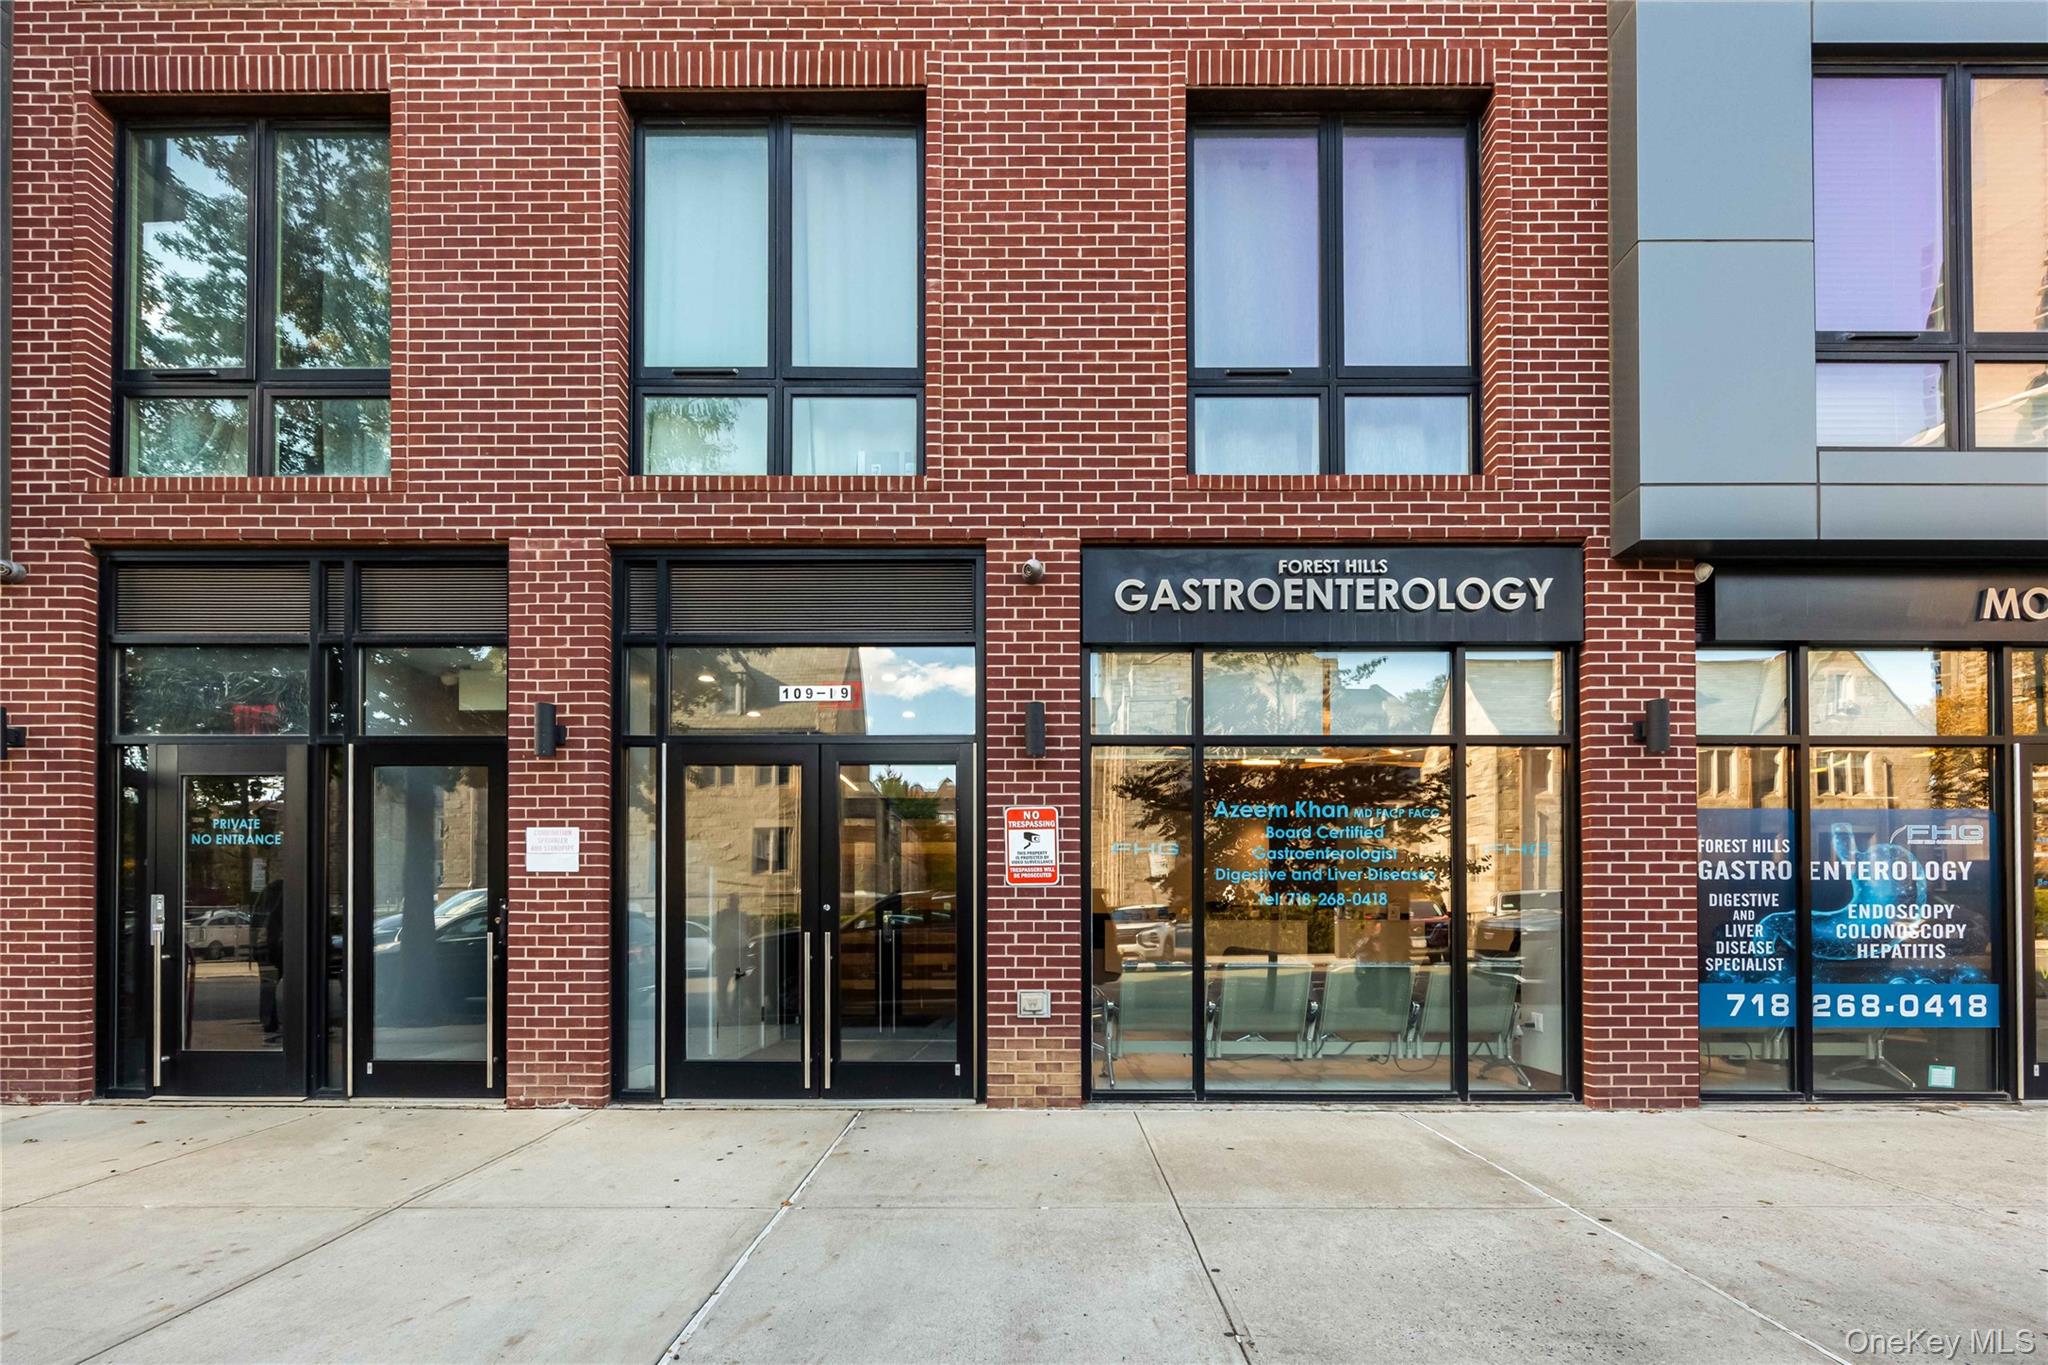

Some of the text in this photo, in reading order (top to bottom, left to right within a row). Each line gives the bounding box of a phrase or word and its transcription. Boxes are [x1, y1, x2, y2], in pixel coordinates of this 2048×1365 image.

[1278, 559, 1388, 574] FOREST HILLS
[1114, 577, 1554, 612] GASTROENTEROLOGY
[1023, 811, 1039, 819] NO
[1214, 801, 1288, 818] Azeem
[1295, 801, 1349, 818] Khan
[1353, 808, 1373, 818] MD
[1376, 808, 1404, 818] FACP
[212, 818, 261, 829] PRIVATE
[191, 834, 282, 845] NO ENTRANCE
[1265, 825, 1384, 839] Board Certified
[1907, 825, 1984, 840] FHG
[1698, 839, 1790, 853] FOREST HILLS
[1215, 868, 1287, 883] Digestive
[1292, 868, 1322, 881] and
[1327, 868, 1362, 881] Liver
[1698, 860, 1973, 881] GASTRO ENTEROLOGY
[1287, 893, 1387, 906] 718-268-0418
[1709, 893, 1779, 907] DIGESTIVE
[1733, 910, 1755, 921] AND
[1848, 904, 1955, 919] ENDOSCOPY
[1725, 924, 1764, 938] LIVER
[1836, 923, 1967, 939] COLONOSCOPY
[1716, 941, 1774, 955] DISEASE
[1857, 943, 1946, 959] HEPATITIS
[1705, 957, 1784, 972] SPECIALIST
[1726, 993, 1988, 1017] 718 268-0418
